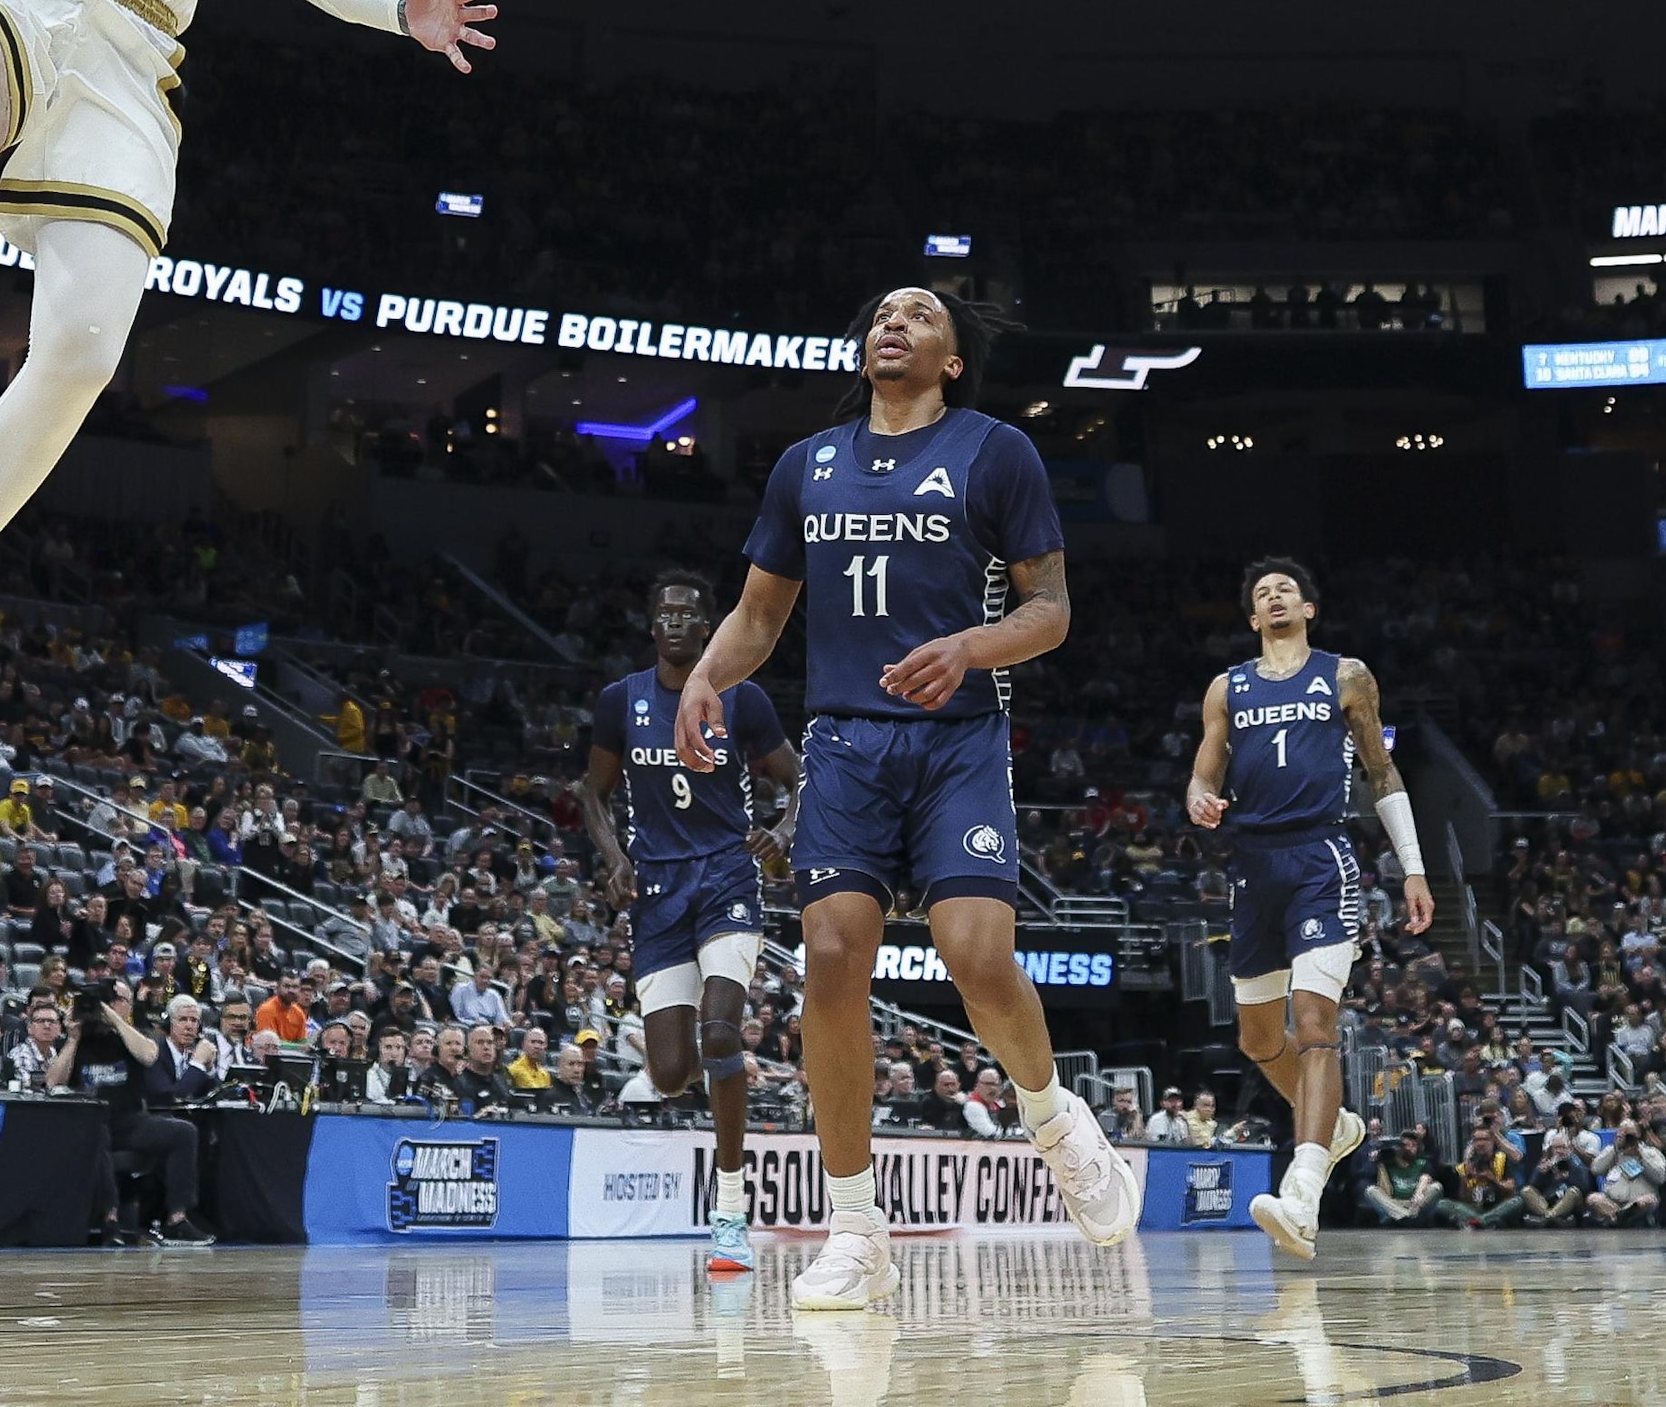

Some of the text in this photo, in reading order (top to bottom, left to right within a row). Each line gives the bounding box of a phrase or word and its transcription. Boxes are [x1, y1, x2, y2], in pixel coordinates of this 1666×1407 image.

[145, 255, 304, 314] ROYALS
[320, 286, 364, 322] VS
[375, 293, 550, 345] PURDUE
[803, 512, 952, 544] QUEENS
[842, 554, 891, 618] 11
[1233, 701, 1333, 730] QUEENS
[1270, 728, 1289, 769] 1
[671, 772, 693, 811] 9
[411, 1146, 473, 1180] MARCH
[417, 1180, 498, 1214] MADNESS
